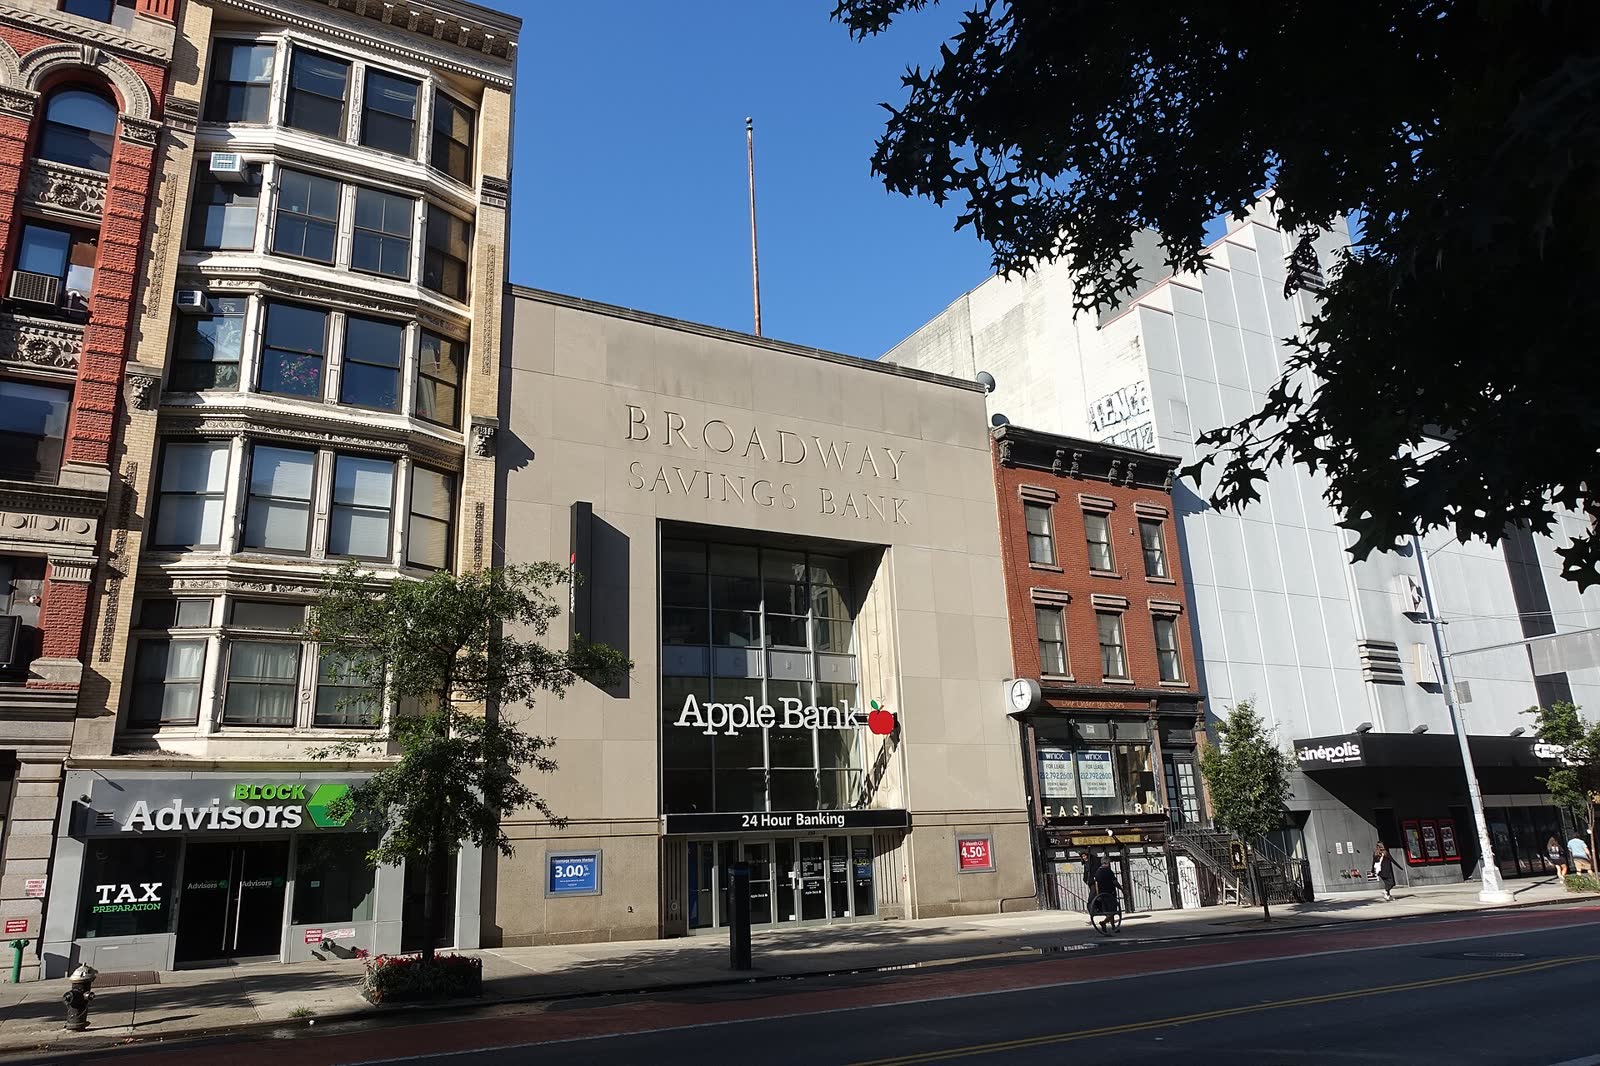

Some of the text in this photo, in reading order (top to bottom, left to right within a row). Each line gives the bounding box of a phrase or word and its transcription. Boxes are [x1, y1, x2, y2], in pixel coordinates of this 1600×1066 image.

[624, 404, 907, 481] BROADWAY
[628, 461, 912, 526] SAVINGS BANK
[673, 693, 864, 736] Apple Bank
[1298, 741, 1361, 761] cinépolis
[233, 784, 307, 800] BLOCK
[120, 798, 303, 832] Advisors
[742, 812, 845, 827] 24 Hour Banking
[1044, 803, 1165, 817] EAST 8TH
[96, 882, 162, 904] TAX
[92, 903, 161, 913] PREPARATION
